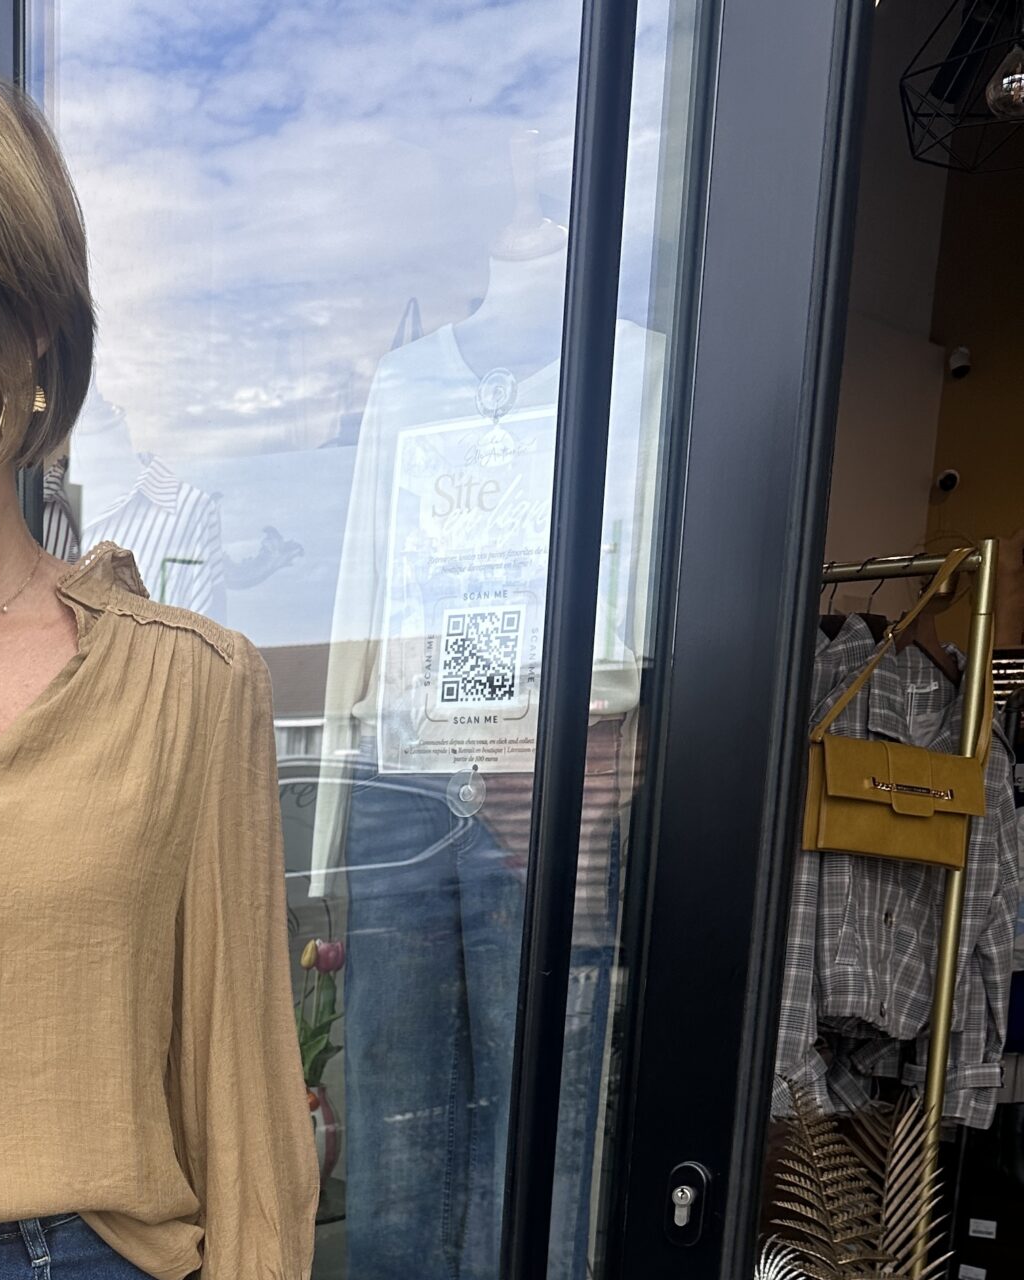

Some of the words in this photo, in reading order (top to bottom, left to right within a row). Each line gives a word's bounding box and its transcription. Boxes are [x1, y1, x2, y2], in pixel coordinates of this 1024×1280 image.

[431, 472, 501, 518] Site
[463, 591, 490, 601] SCAN
[494, 590, 508, 599] ME
[427, 634, 435, 650] ME
[529, 627, 539, 660] SCAN
[423, 655, 432, 687] SCAN
[527, 666, 536, 683] ME
[453, 716, 480, 725] SCAN
[484, 715, 499, 724] ME
